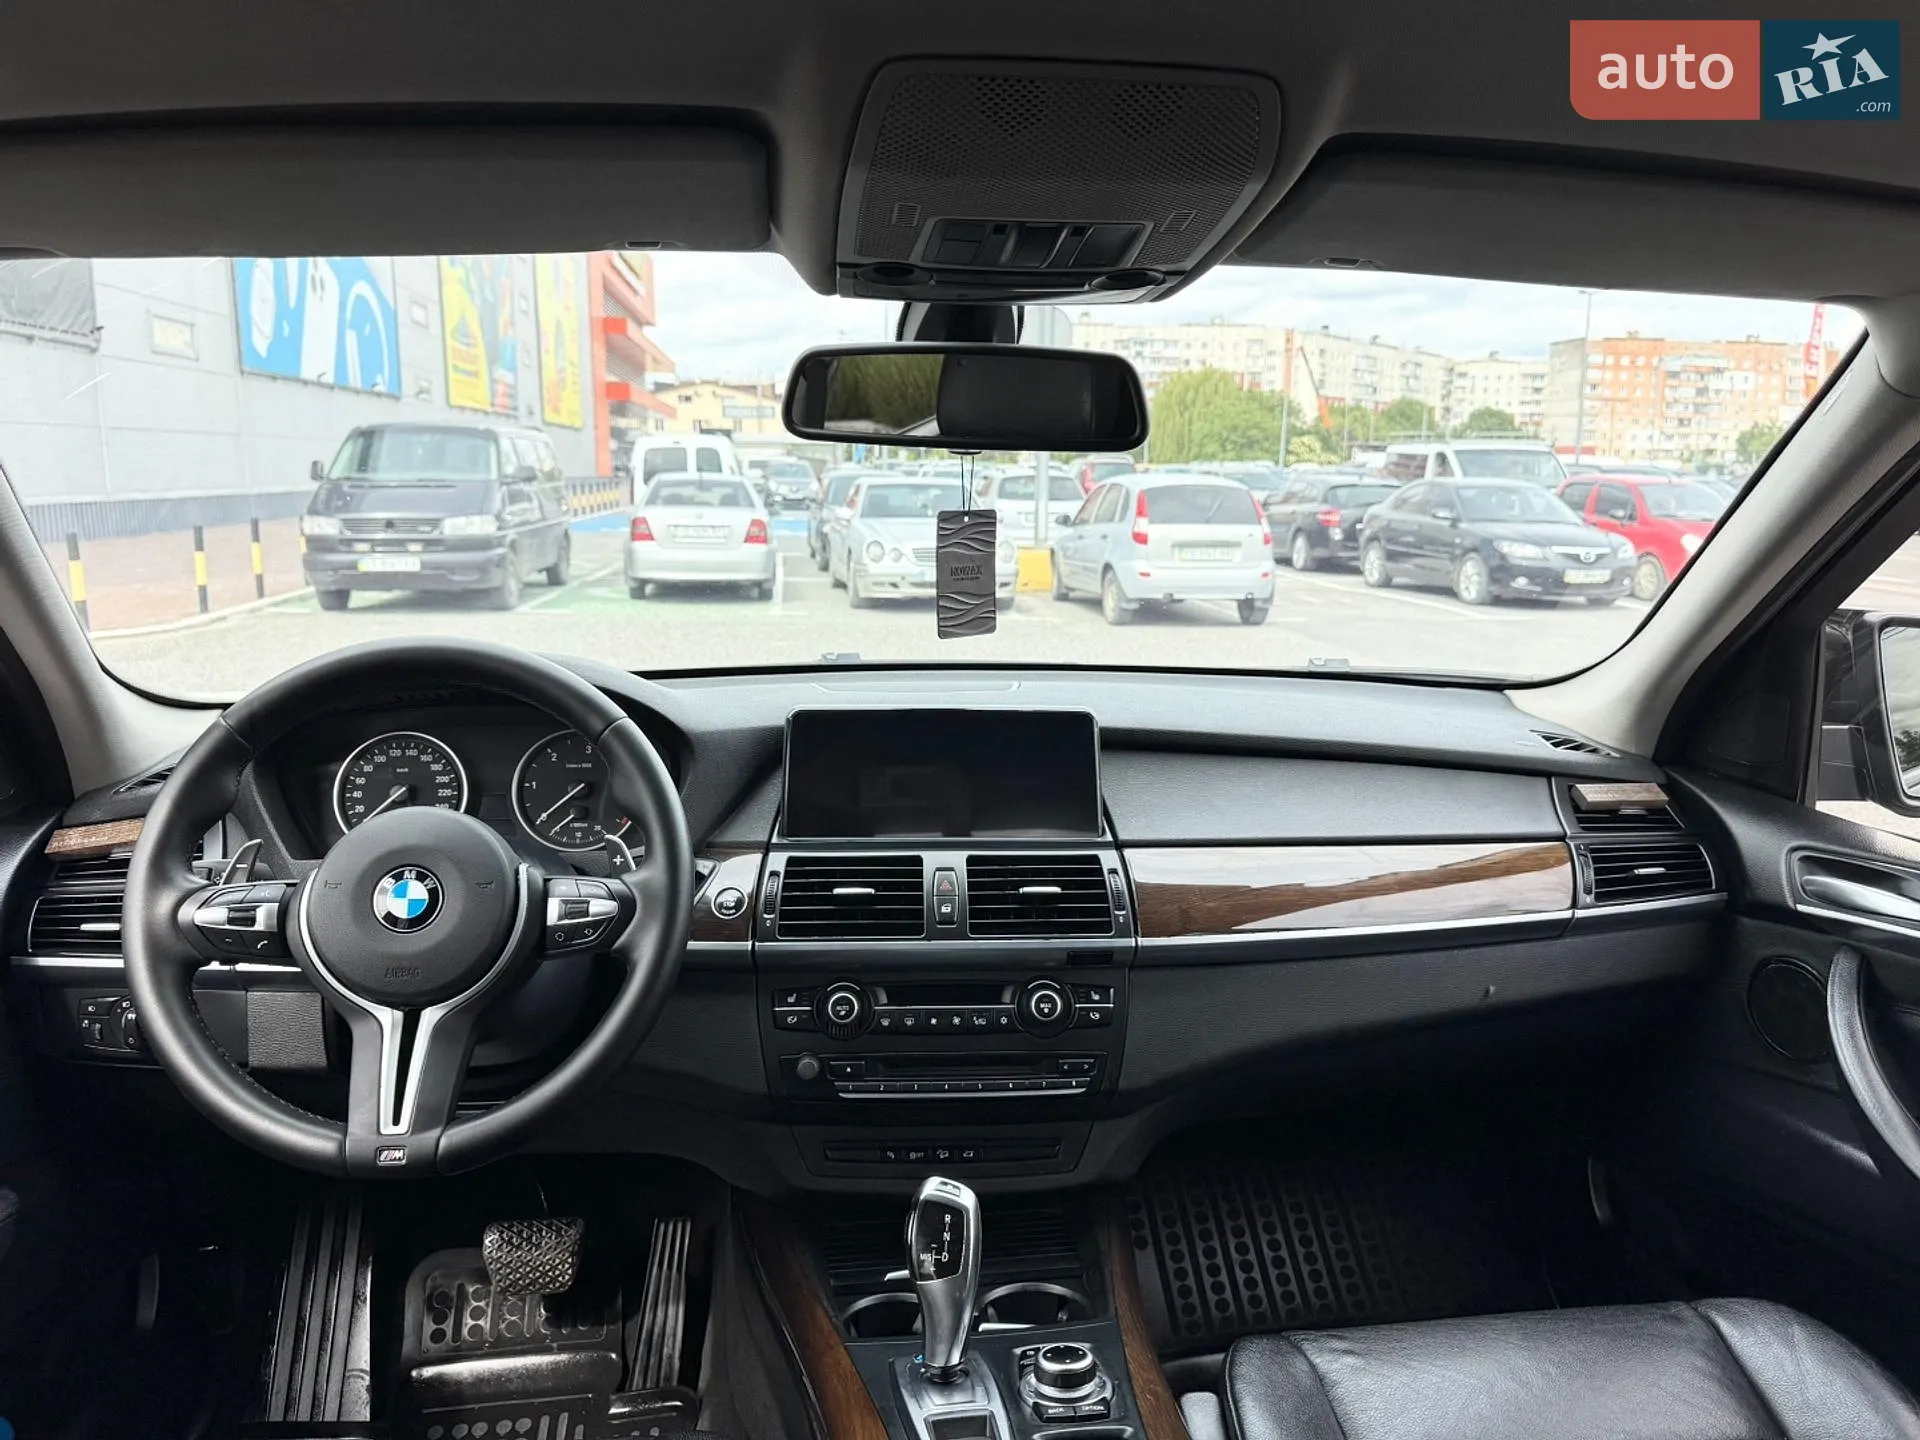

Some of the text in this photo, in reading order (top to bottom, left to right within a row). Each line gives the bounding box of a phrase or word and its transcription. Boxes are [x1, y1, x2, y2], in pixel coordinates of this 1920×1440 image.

[585, 745, 592, 754] 3
[373, 755, 387, 763] 100
[420, 754, 433, 762] 160
[551, 753, 559, 762] 2
[363, 764, 374, 772] 80
[430, 763, 443, 771] 180
[355, 777, 366, 785] 60
[435, 775, 449, 783] 200
[531, 781, 537, 790] 1
[352, 790, 363, 798] 40
[437, 789, 452, 797] 220
[354, 805, 365, 813] 20
[383, 869, 437, 890] BMW
[944, 1214, 952, 1224] R
[942, 1231, 951, 1241] N
[941, 1252, 950, 1262] D
